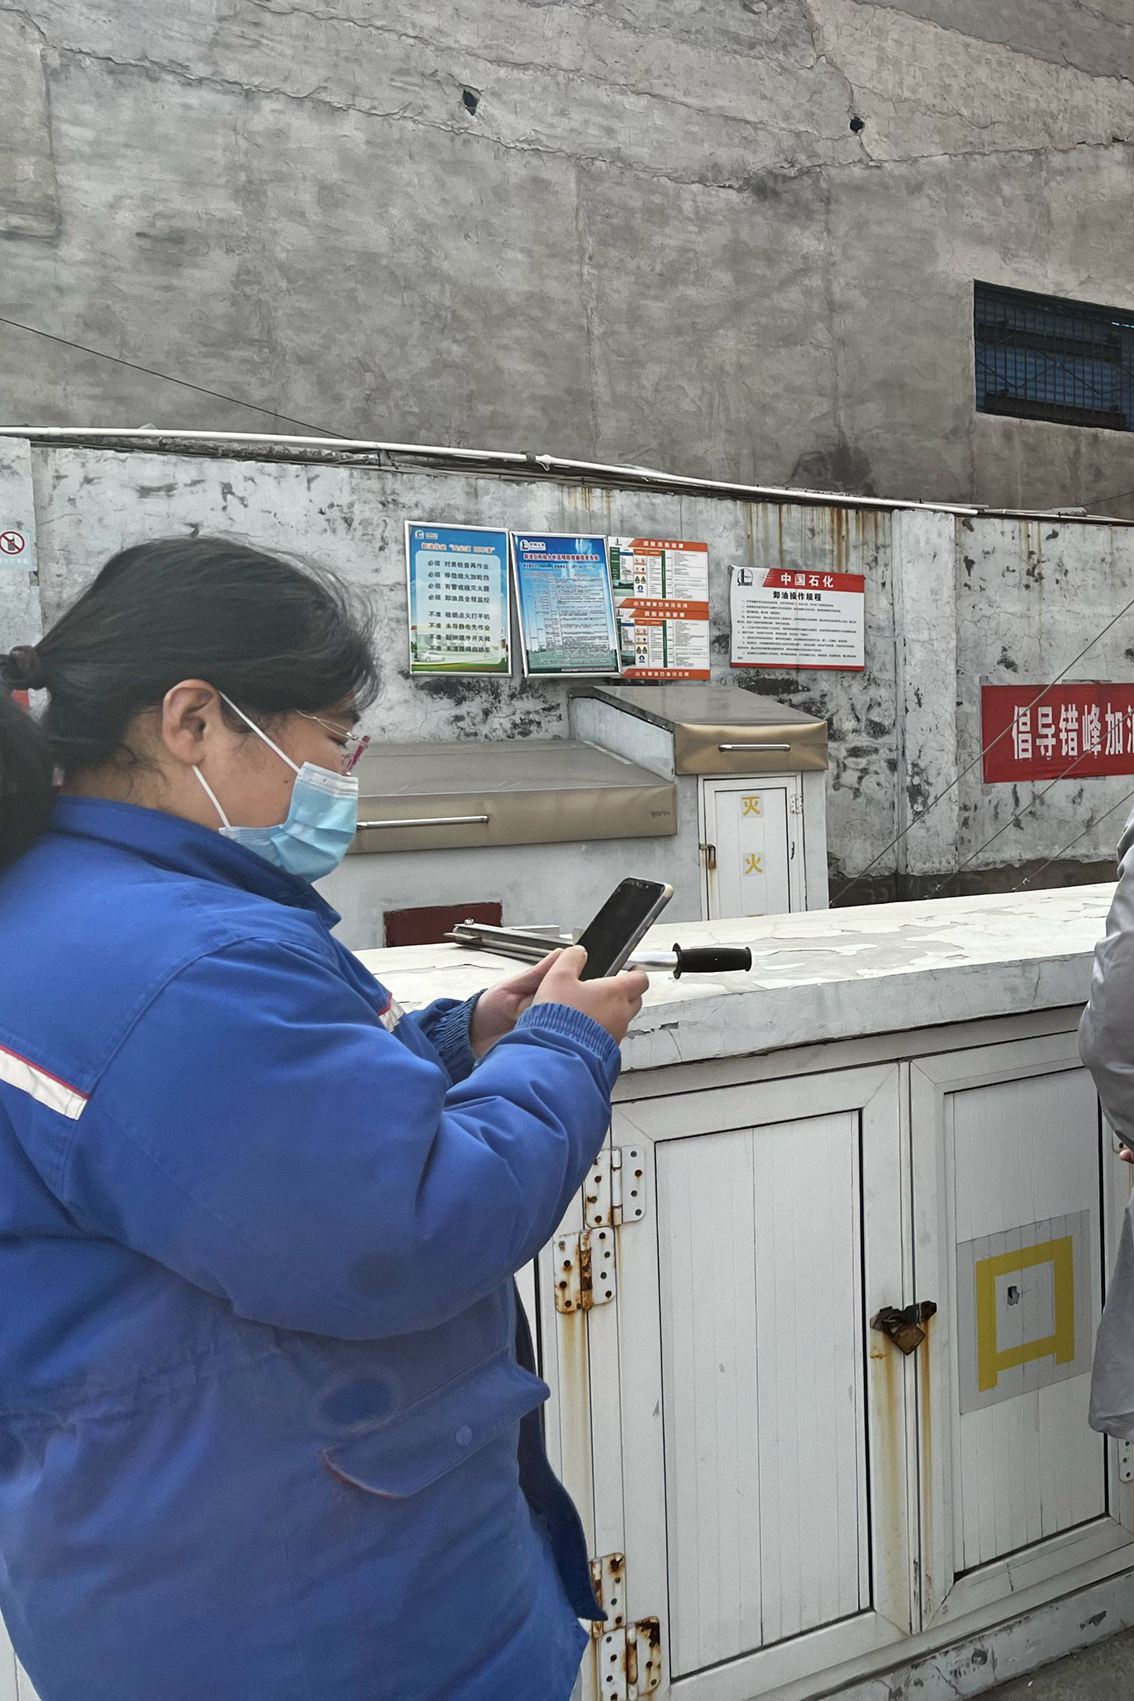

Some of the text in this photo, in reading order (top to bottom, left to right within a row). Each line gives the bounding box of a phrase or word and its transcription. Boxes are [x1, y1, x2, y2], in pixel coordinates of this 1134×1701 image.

[781, 572, 834, 588] 中国石化
[773, 591, 822, 601] 卸油操作规程
